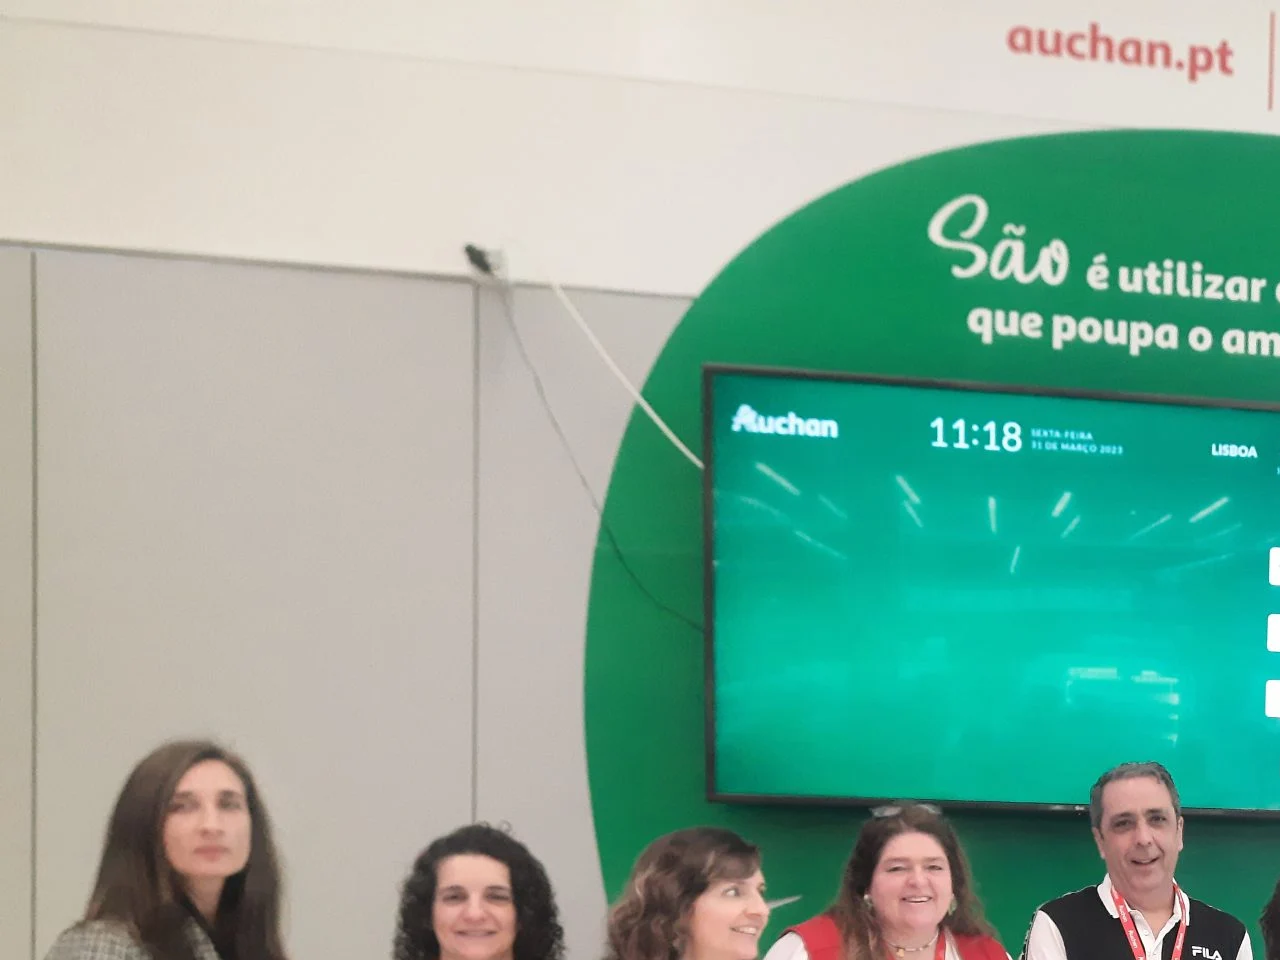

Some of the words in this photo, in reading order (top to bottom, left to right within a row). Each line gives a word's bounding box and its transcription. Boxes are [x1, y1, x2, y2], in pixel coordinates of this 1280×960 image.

[1006, 21, 1234, 83] auchan.pt
[927, 193, 1070, 286] São
[1086, 253, 1109, 292] é
[1118, 259, 1266, 304] utilizar
[967, 305, 1043, 345] que
[1053, 312, 1179, 355] poupa
[1188, 326, 1213, 351] o
[731, 404, 839, 438] Auchan
[929, 417, 1022, 452] 11:18
[1211, 443, 1258, 459] LISBOA
